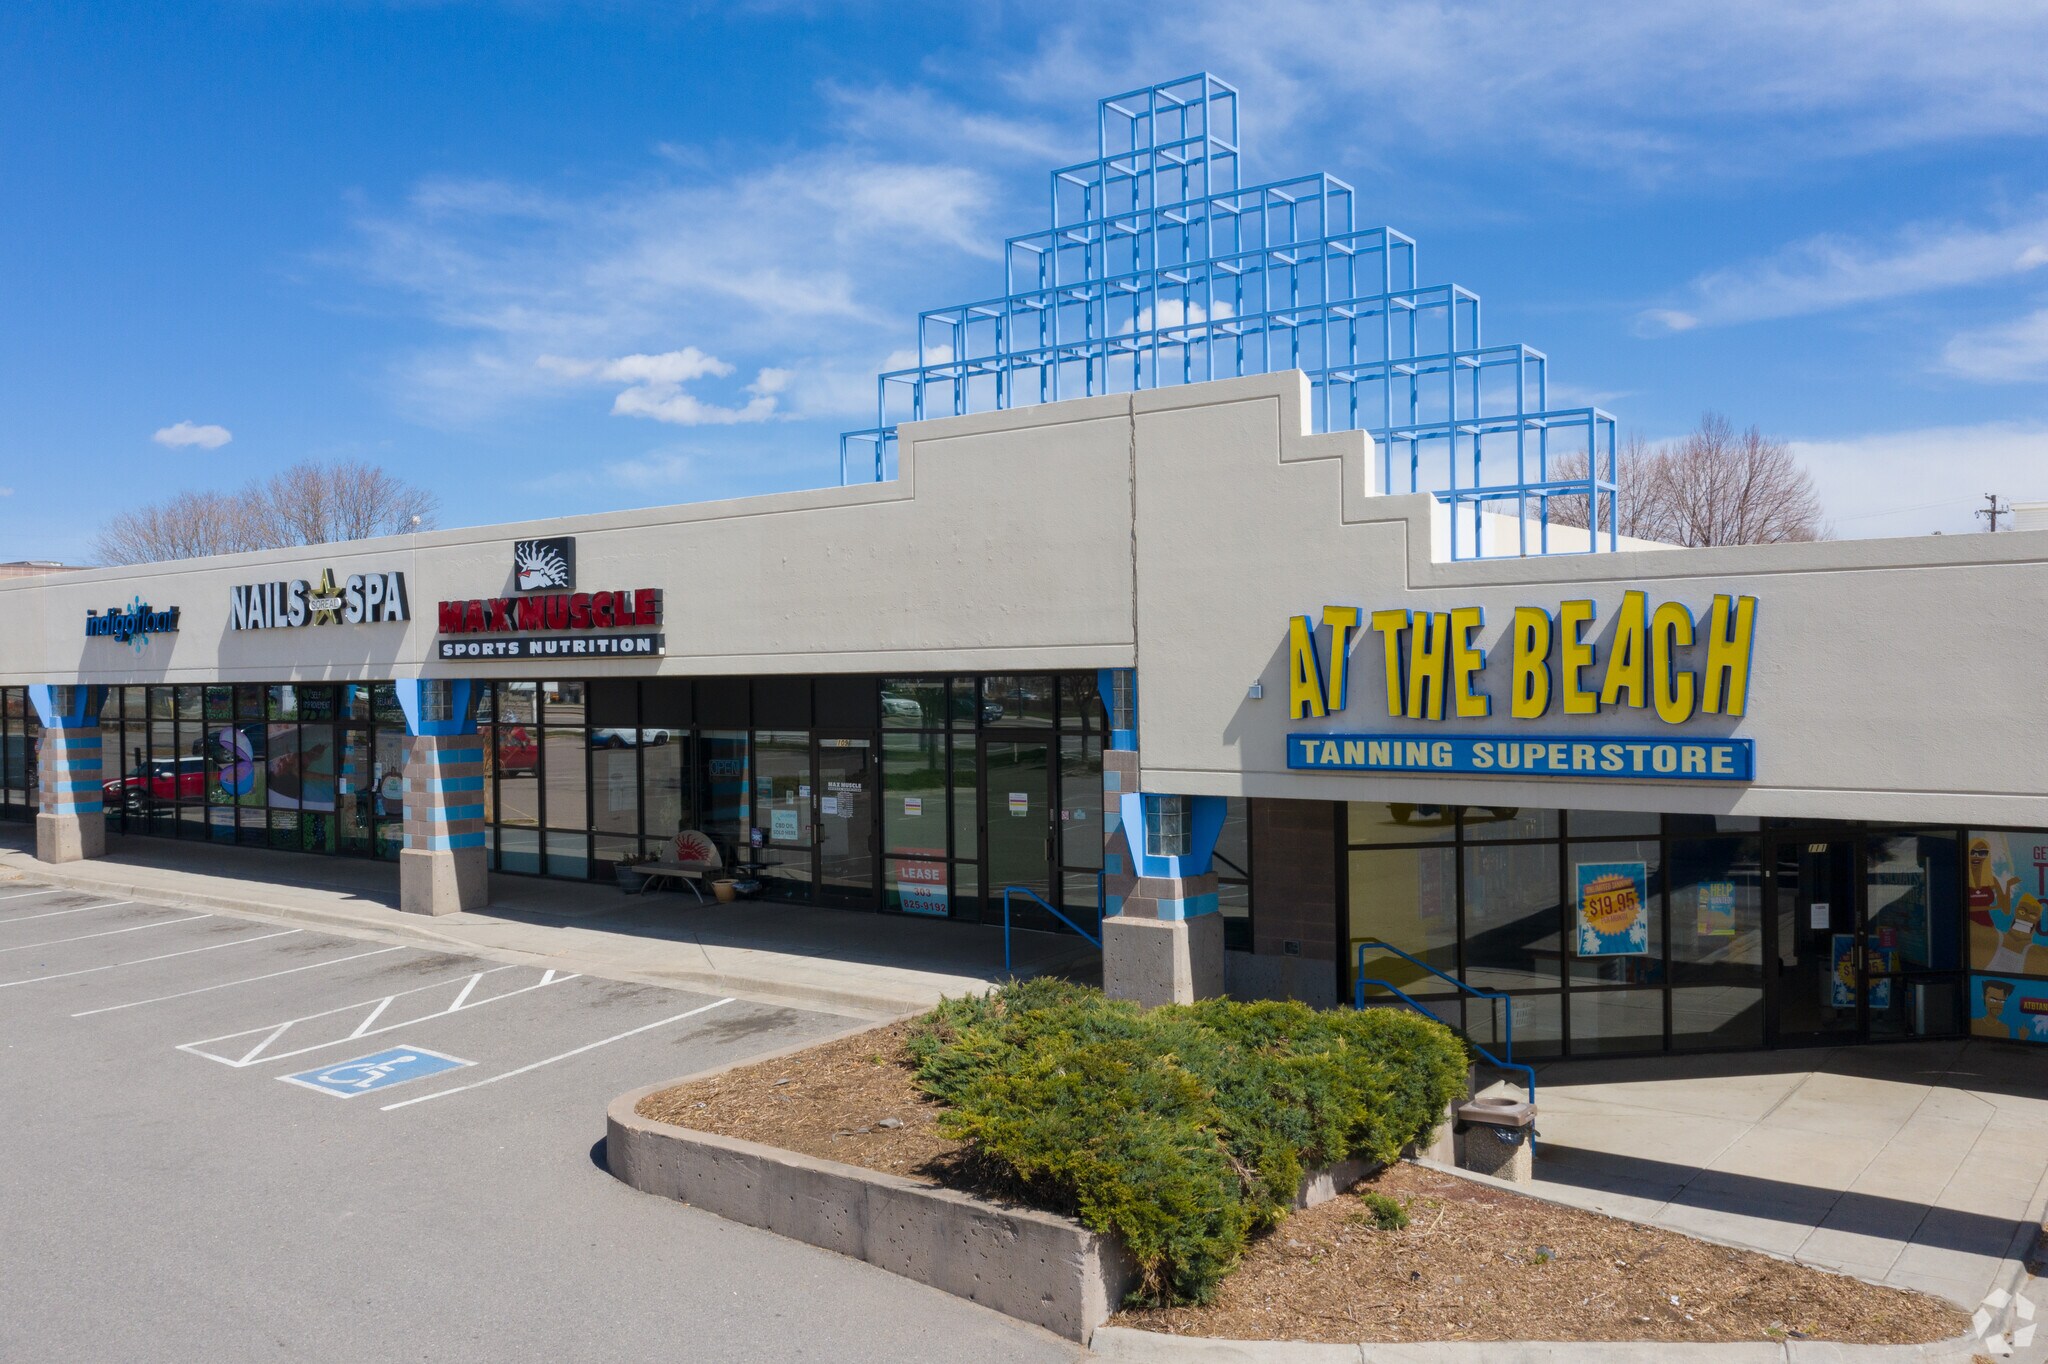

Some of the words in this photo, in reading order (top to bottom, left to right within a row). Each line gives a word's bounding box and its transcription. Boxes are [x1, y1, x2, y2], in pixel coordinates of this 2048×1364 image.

[230, 579, 309, 631] NAILS
[346, 571, 408, 624] SPA
[438, 597, 512, 634] MAX
[517, 588, 661, 631] MUSCLE
[442, 641, 520, 657] SPORTS
[529, 638, 651, 655] NUTRITION
[1289, 605, 1362, 720] AT
[1371, 607, 1492, 721] THE
[1511, 590, 1759, 724] BEACH
[1300, 739, 1453, 767] TANNING
[1472, 742, 1735, 774] SUPERSTORE
[711, 761, 738, 774] OPEN
[902, 867, 940, 880] LEASE
[914, 888, 931, 897] 303
[1710, 884, 1733, 897] HELP
[904, 899, 946, 912] 825-9192
[1589, 891, 1635, 917] $19.95
